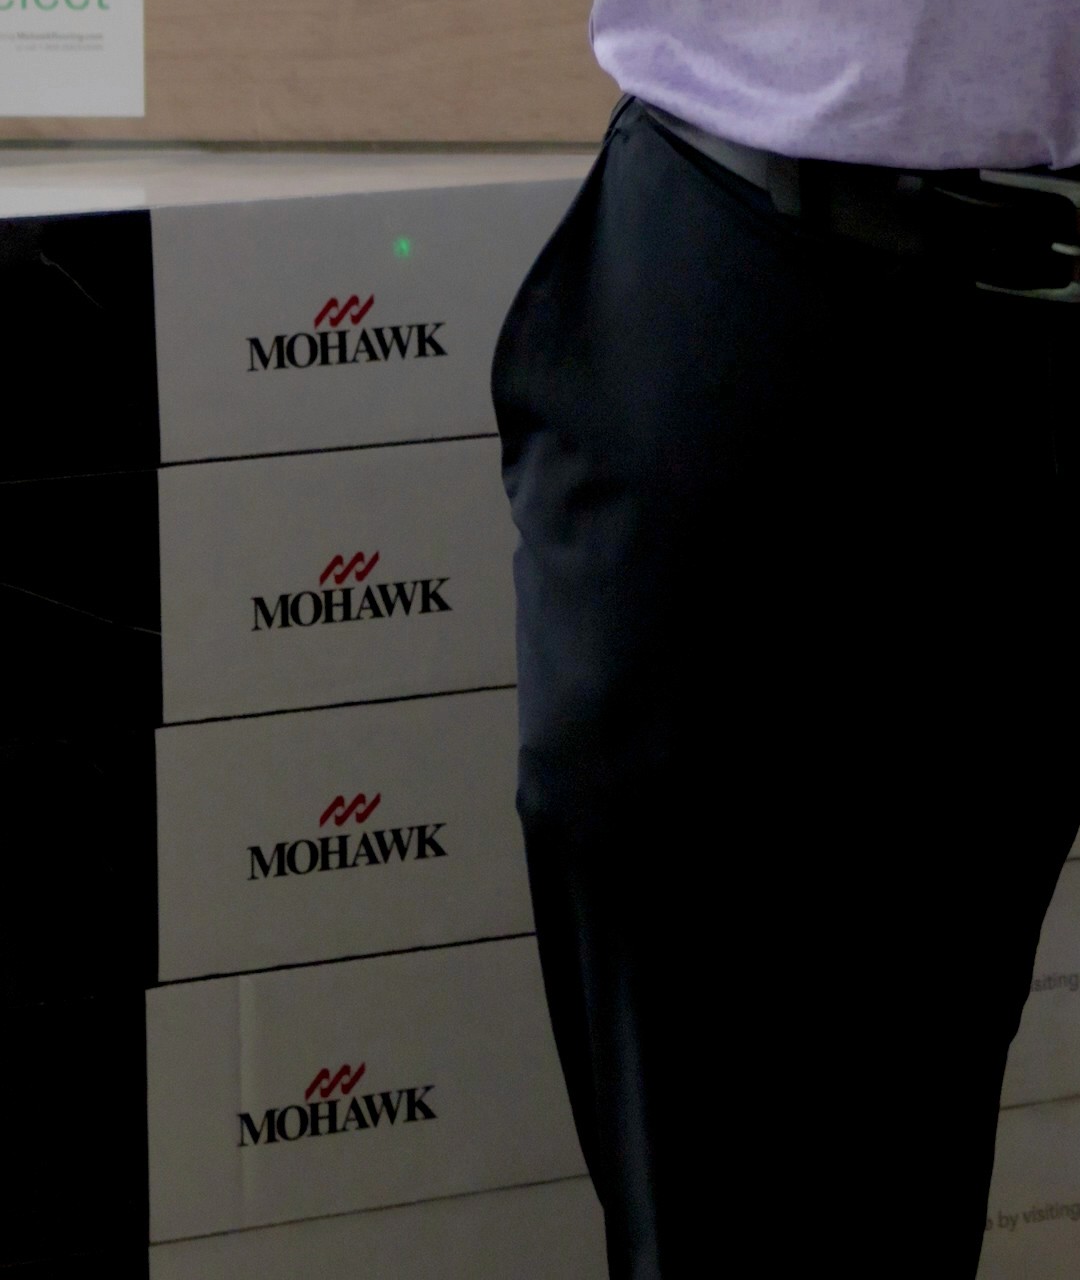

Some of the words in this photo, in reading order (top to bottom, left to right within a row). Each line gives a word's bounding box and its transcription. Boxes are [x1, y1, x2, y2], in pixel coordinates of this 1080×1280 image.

[246, 322, 448, 372] MOHAWK
[251, 577, 453, 631] MOHAWK
[247, 822, 448, 880] MOHAWK
[237, 1084, 438, 1147] MOHAWK
[997, 1210, 1019, 1232] by
